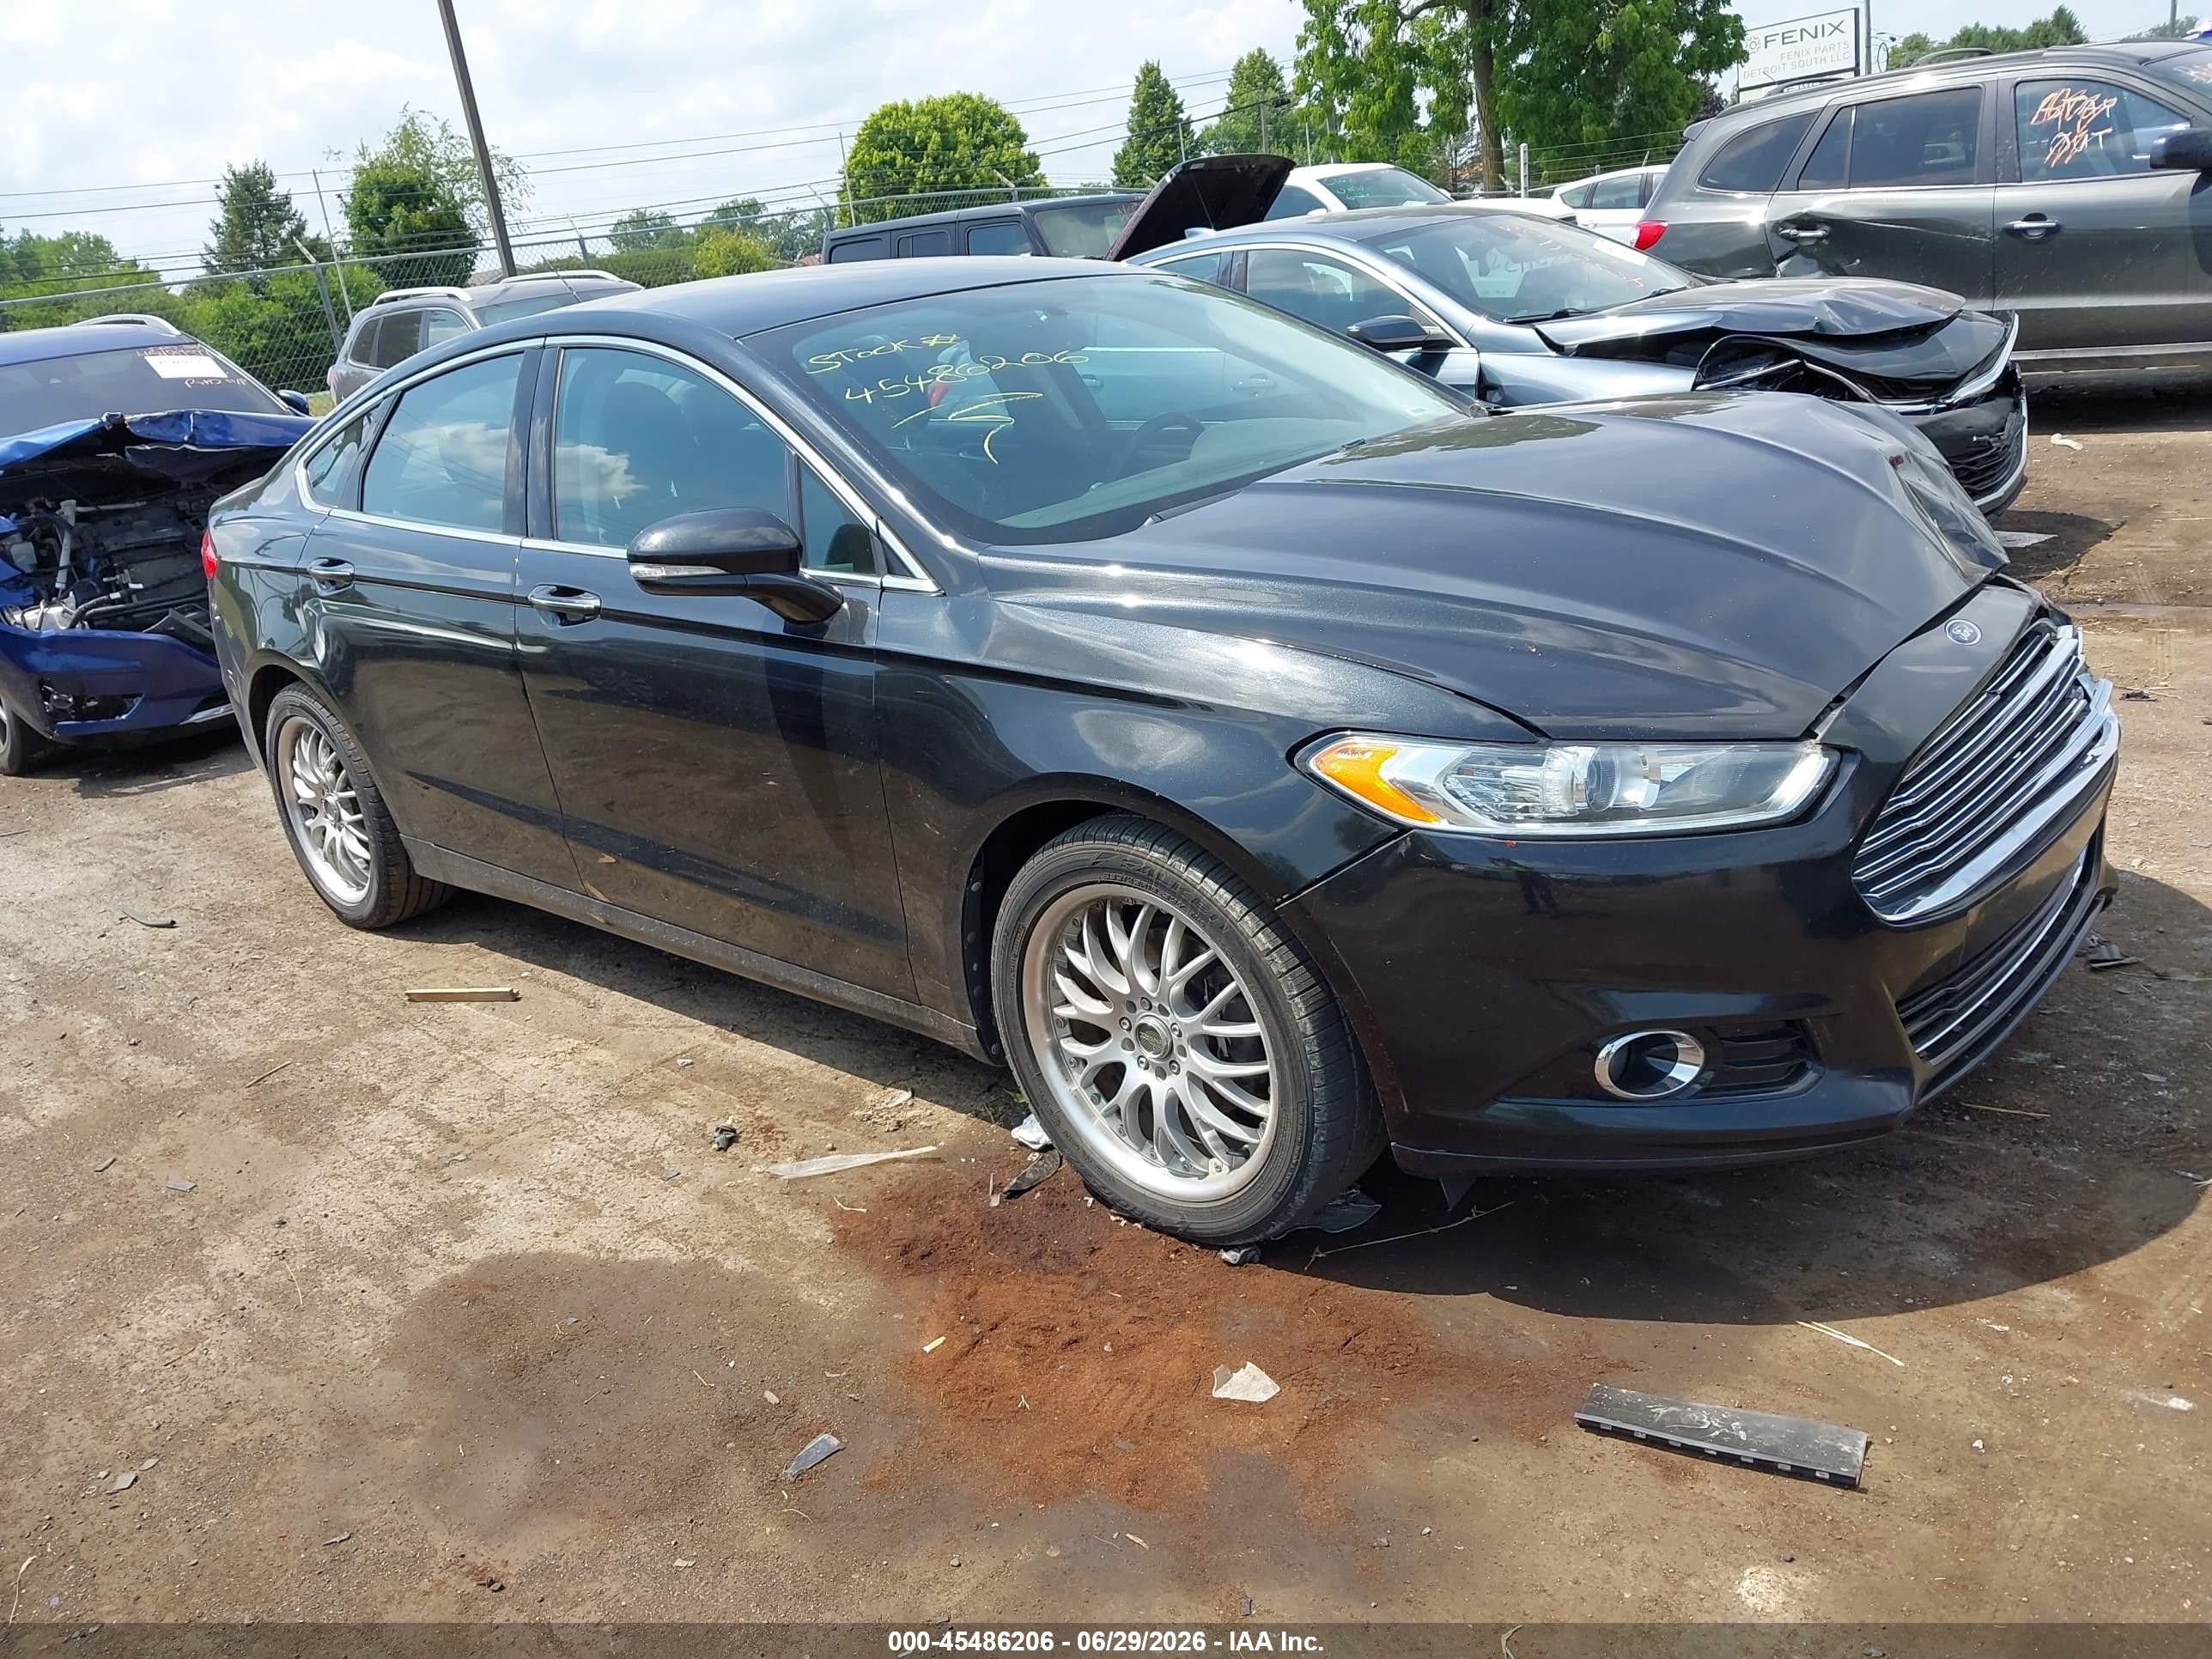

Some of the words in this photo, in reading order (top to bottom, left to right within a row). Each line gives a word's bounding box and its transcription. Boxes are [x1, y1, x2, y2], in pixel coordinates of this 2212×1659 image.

[1765, 20, 1845, 49] FENIX
[1780, 49, 1812, 62] FENIX
[1815, 41, 1850, 55] PARTS
[1743, 63, 1787, 80] DETROIT
[1791, 56, 1827, 70] SOUTH
[1831, 52, 1850, 64] LLC
[921, 333, 962, 348] #
[844, 349, 1090, 404] 45486206
